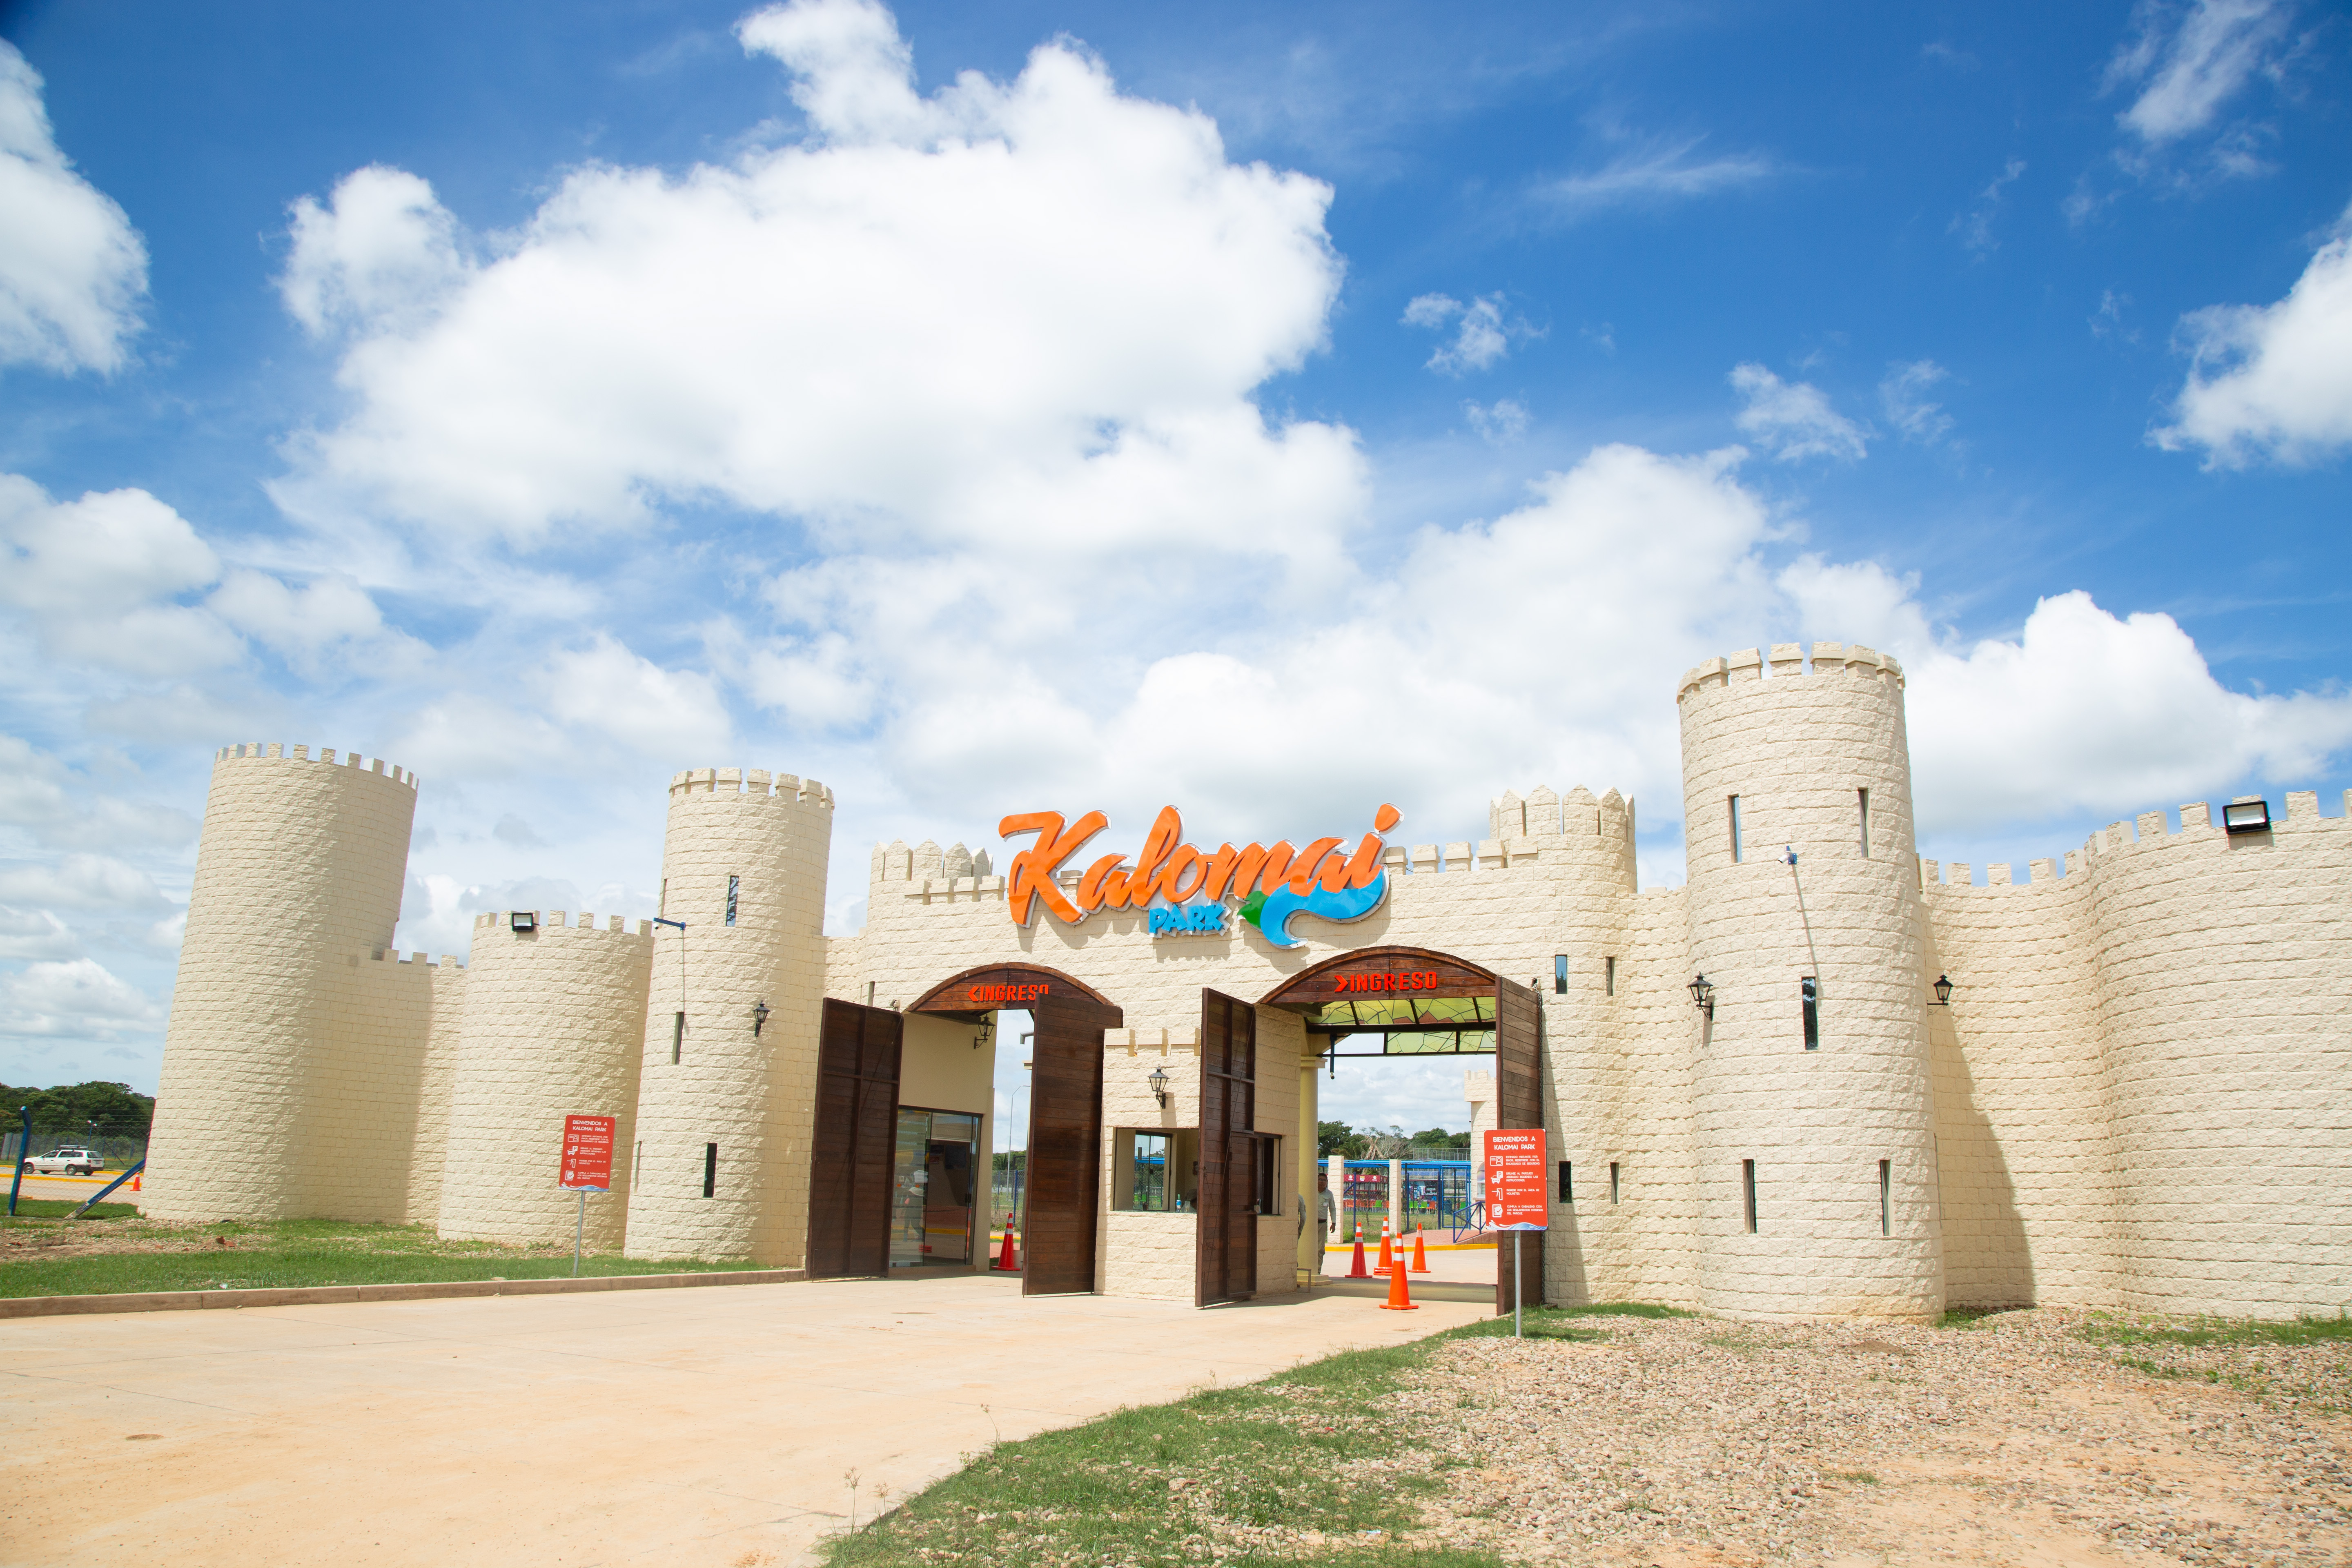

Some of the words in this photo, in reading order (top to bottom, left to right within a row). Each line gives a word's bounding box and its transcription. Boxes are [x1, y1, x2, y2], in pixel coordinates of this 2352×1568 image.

[998, 802, 1403, 927] Kalomai
[1148, 903, 1228, 935] PARK
[1350, 971, 1437, 991] INGRESO
